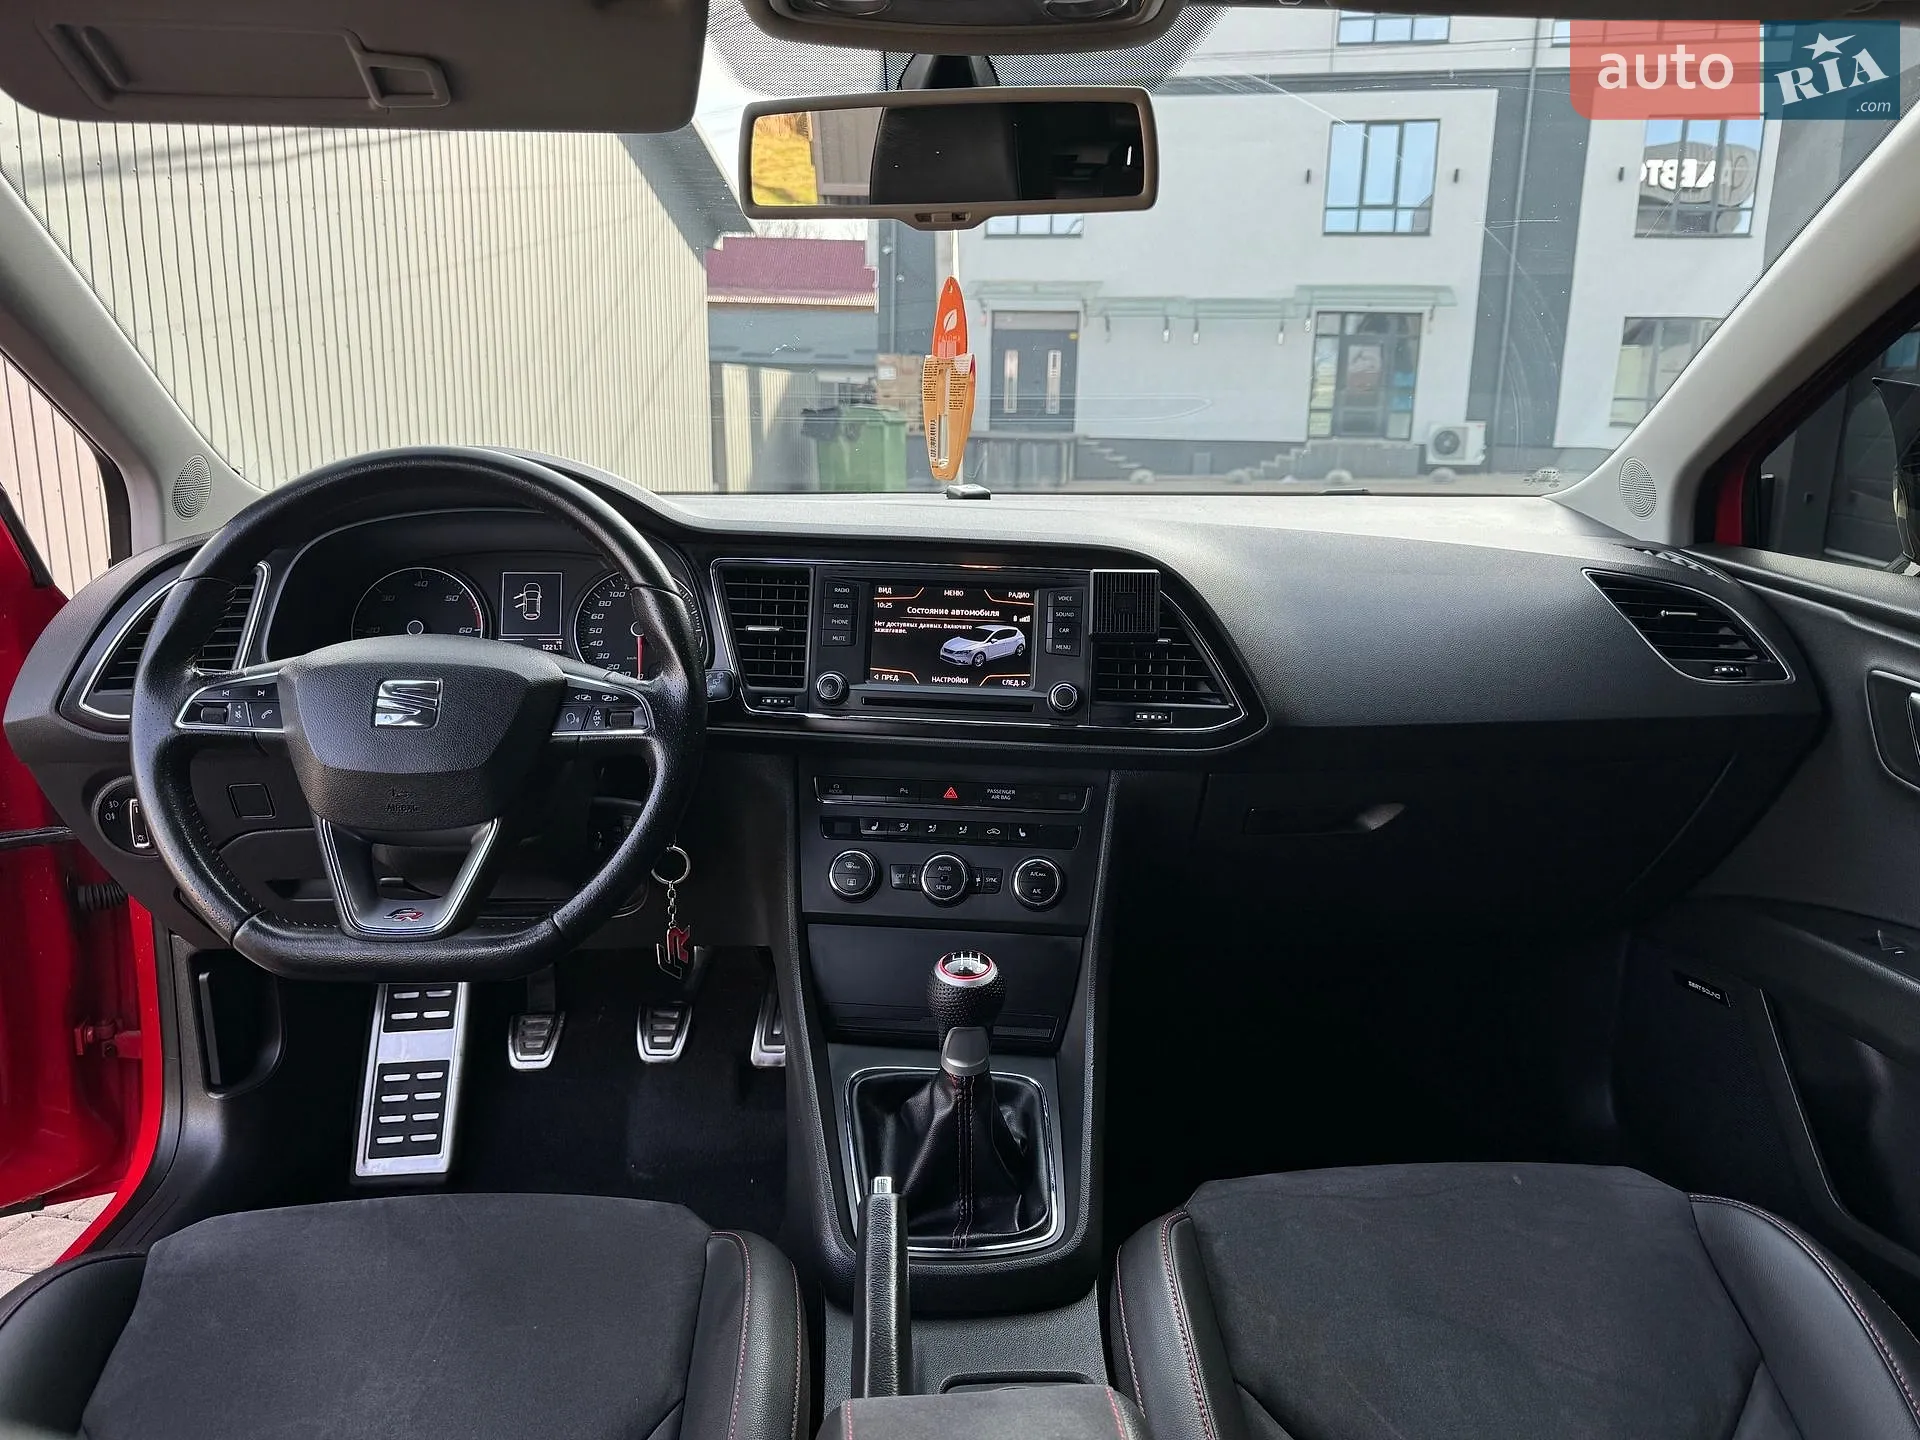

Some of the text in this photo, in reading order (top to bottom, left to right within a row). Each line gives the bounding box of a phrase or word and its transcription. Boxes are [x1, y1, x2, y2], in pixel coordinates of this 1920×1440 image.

[609, 590, 626, 598] 100
[878, 587, 1030, 599] ВИД МЕНЮ РАДИО
[444, 594, 460, 602] 50
[907, 606, 1000, 617] Состояние автомобиля
[458, 626, 472, 634] 60
[589, 639, 603, 647] 40
[881, 673, 900, 682] ПРЕД.
[931, 675, 969, 684] НАСТРОЙКИ
